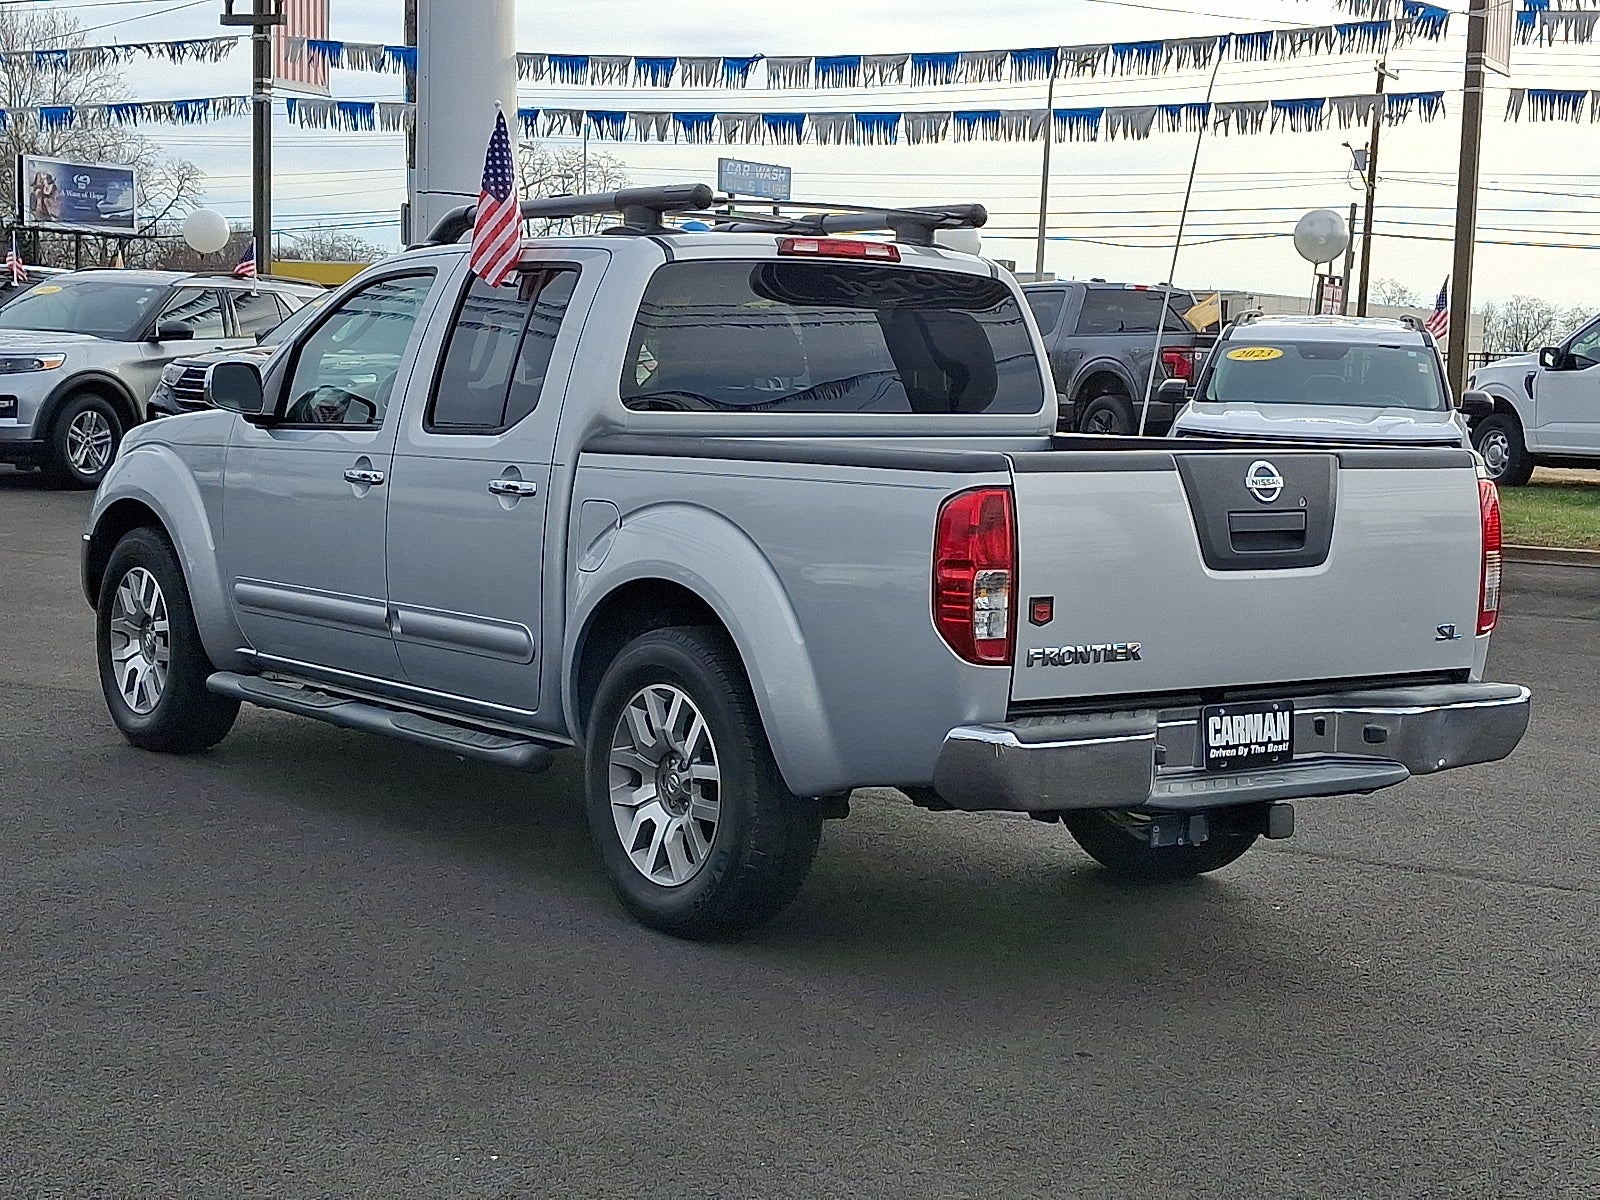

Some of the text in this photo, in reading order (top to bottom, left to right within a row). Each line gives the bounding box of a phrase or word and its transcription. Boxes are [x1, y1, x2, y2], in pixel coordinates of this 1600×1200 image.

[726, 162, 786, 183] CAR WASH
[1234, 349, 1274, 358] 2023
[1251, 478, 1281, 486] NISSAN
[1435, 623, 1462, 641] SL
[1026, 642, 1142, 667] FRONTIER
[1208, 711, 1290, 747] CARMAN
[1209, 741, 1290, 758] Driven By The Best!
